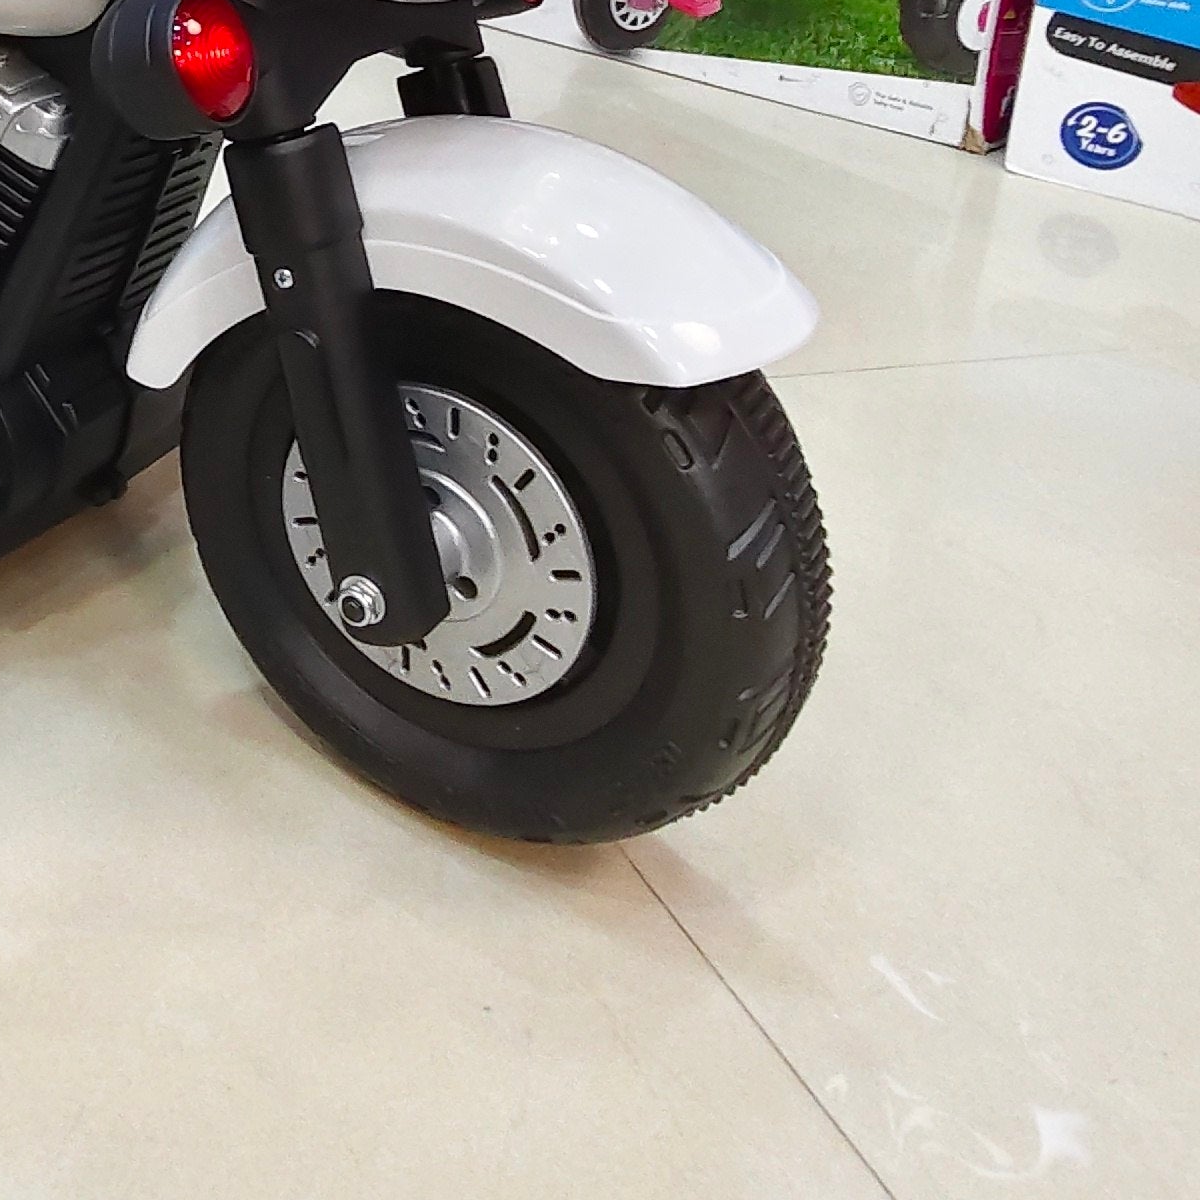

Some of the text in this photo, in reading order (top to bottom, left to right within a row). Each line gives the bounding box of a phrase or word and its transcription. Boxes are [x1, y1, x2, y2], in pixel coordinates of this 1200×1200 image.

[1053, 26, 1177, 73] Easy To Assemble
[1076, 115, 1128, 144] 2-6
[1079, 137, 1117, 157] Years
